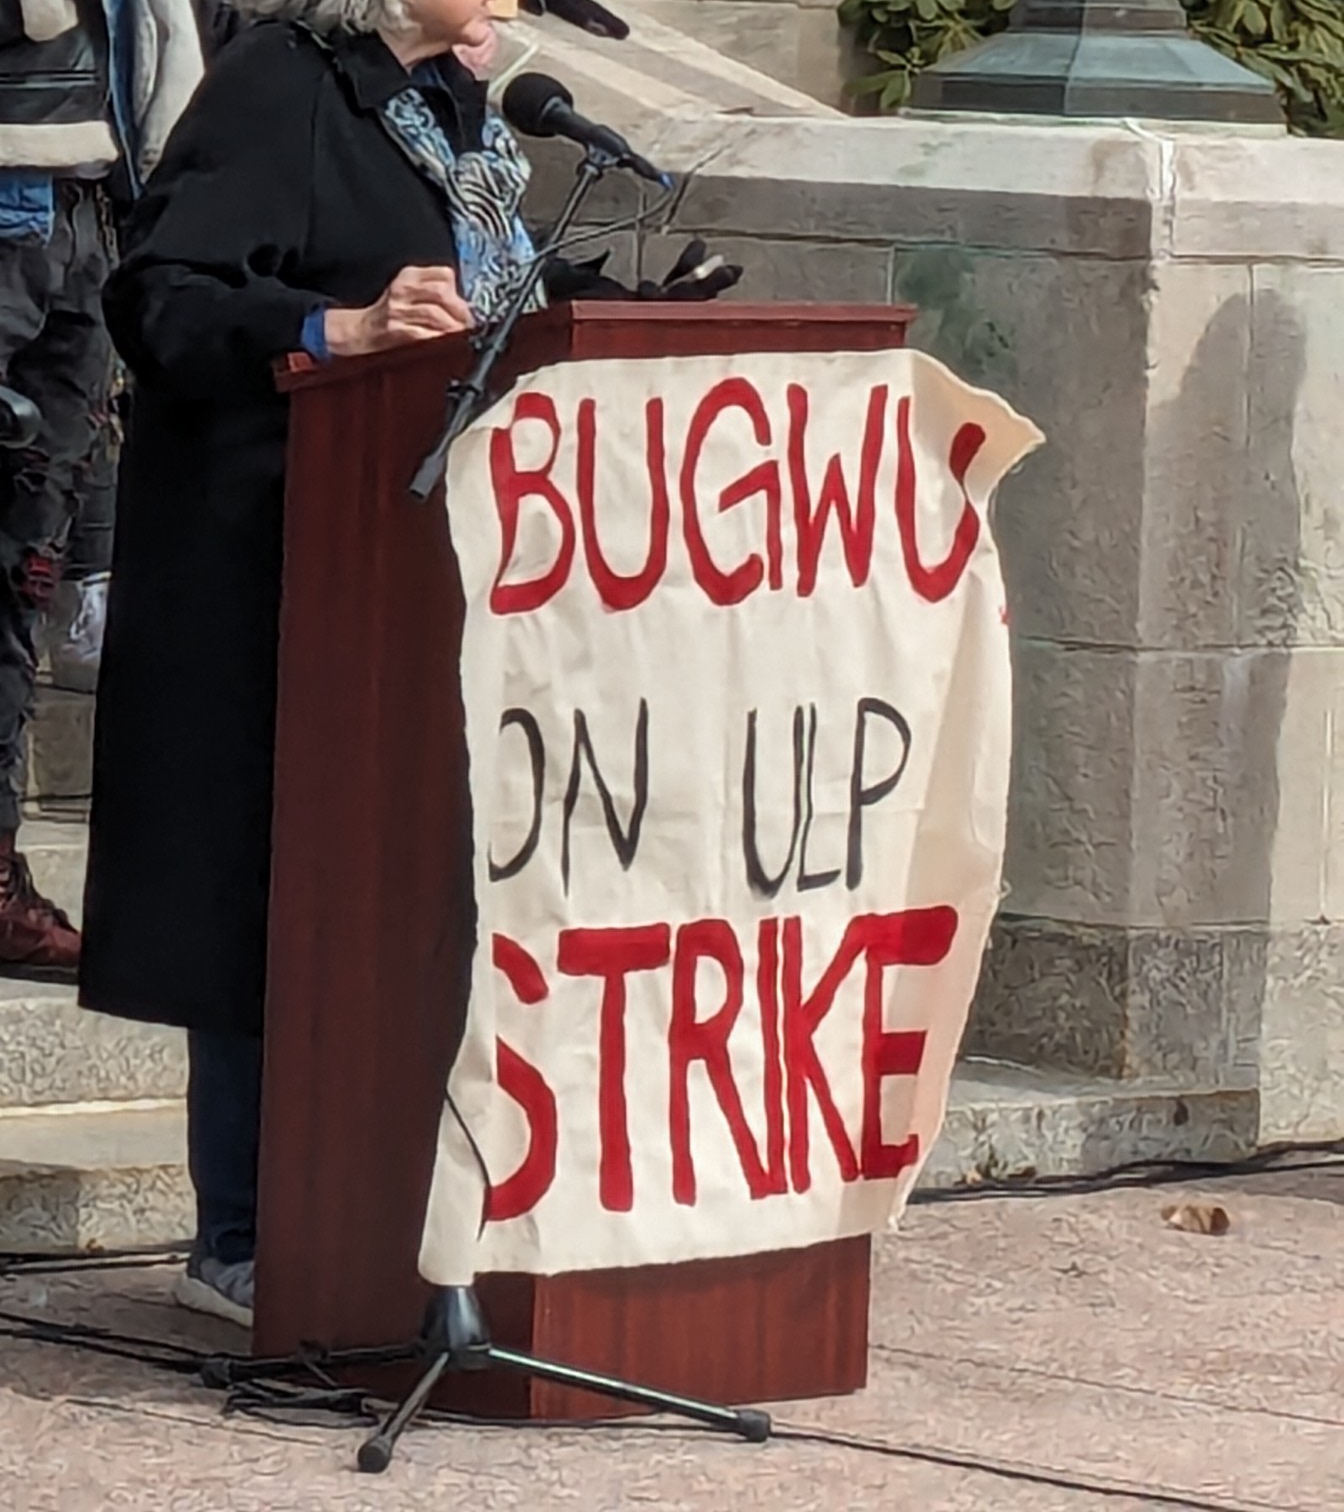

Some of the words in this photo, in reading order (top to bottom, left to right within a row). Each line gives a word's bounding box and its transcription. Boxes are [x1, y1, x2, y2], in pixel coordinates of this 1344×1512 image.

[487, 377, 988, 617] BUGWU
[741, 696, 912, 902] ULP
[483, 904, 959, 1223] STRIKE
